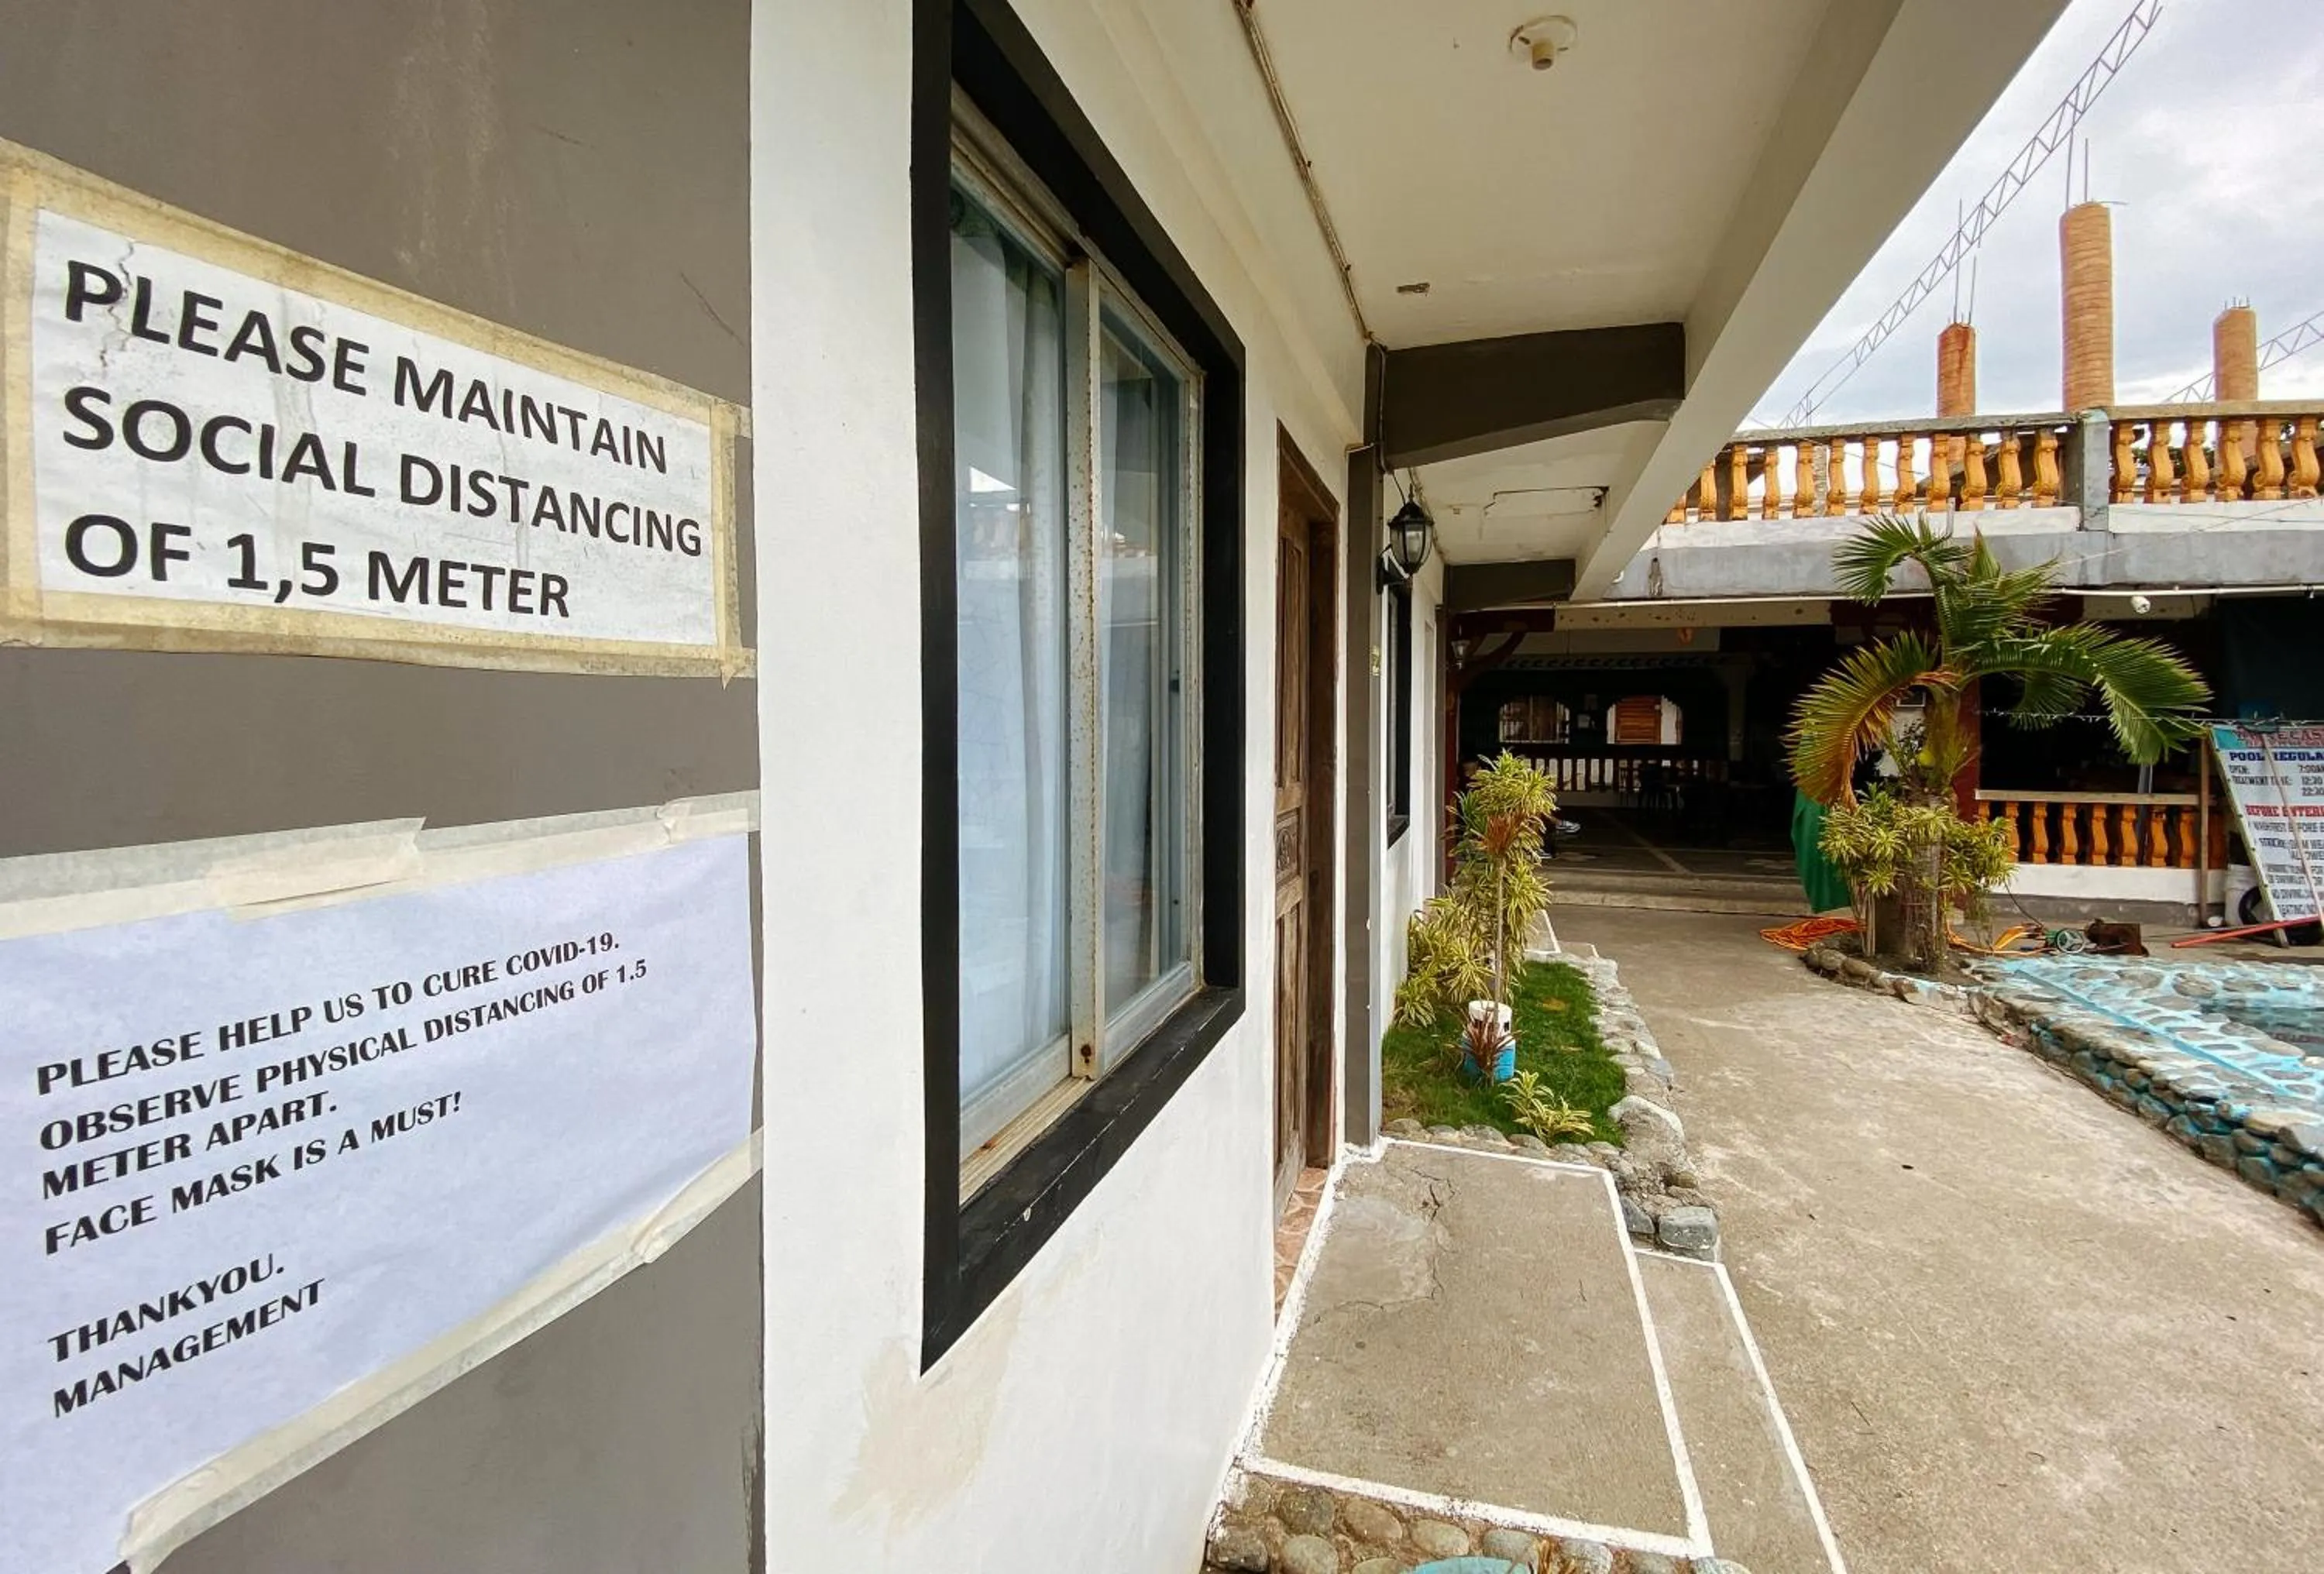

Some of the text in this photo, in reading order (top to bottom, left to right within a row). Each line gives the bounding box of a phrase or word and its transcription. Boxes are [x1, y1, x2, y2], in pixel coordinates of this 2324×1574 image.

[66, 260, 666, 473] PLEASE MAINTAIN
[64, 387, 701, 557] SOCIAL DISTANCING
[65, 514, 569, 617] OF 1,5 METER
[2229, 752, 2264, 761] POOL
[37, 932, 620, 1095] PLEASE HELP US TO CURE COVID-19.
[40, 959, 647, 1150] OBSERVE PHYSICAL DISTANCING OF 1.5
[43, 1091, 337, 1199] METER APART.
[46, 1091, 462, 1255] FACE MASK IS A MUST!
[48, 1253, 285, 1363] THANKYOU.
[54, 1278, 325, 1418] MANAGEMENT
